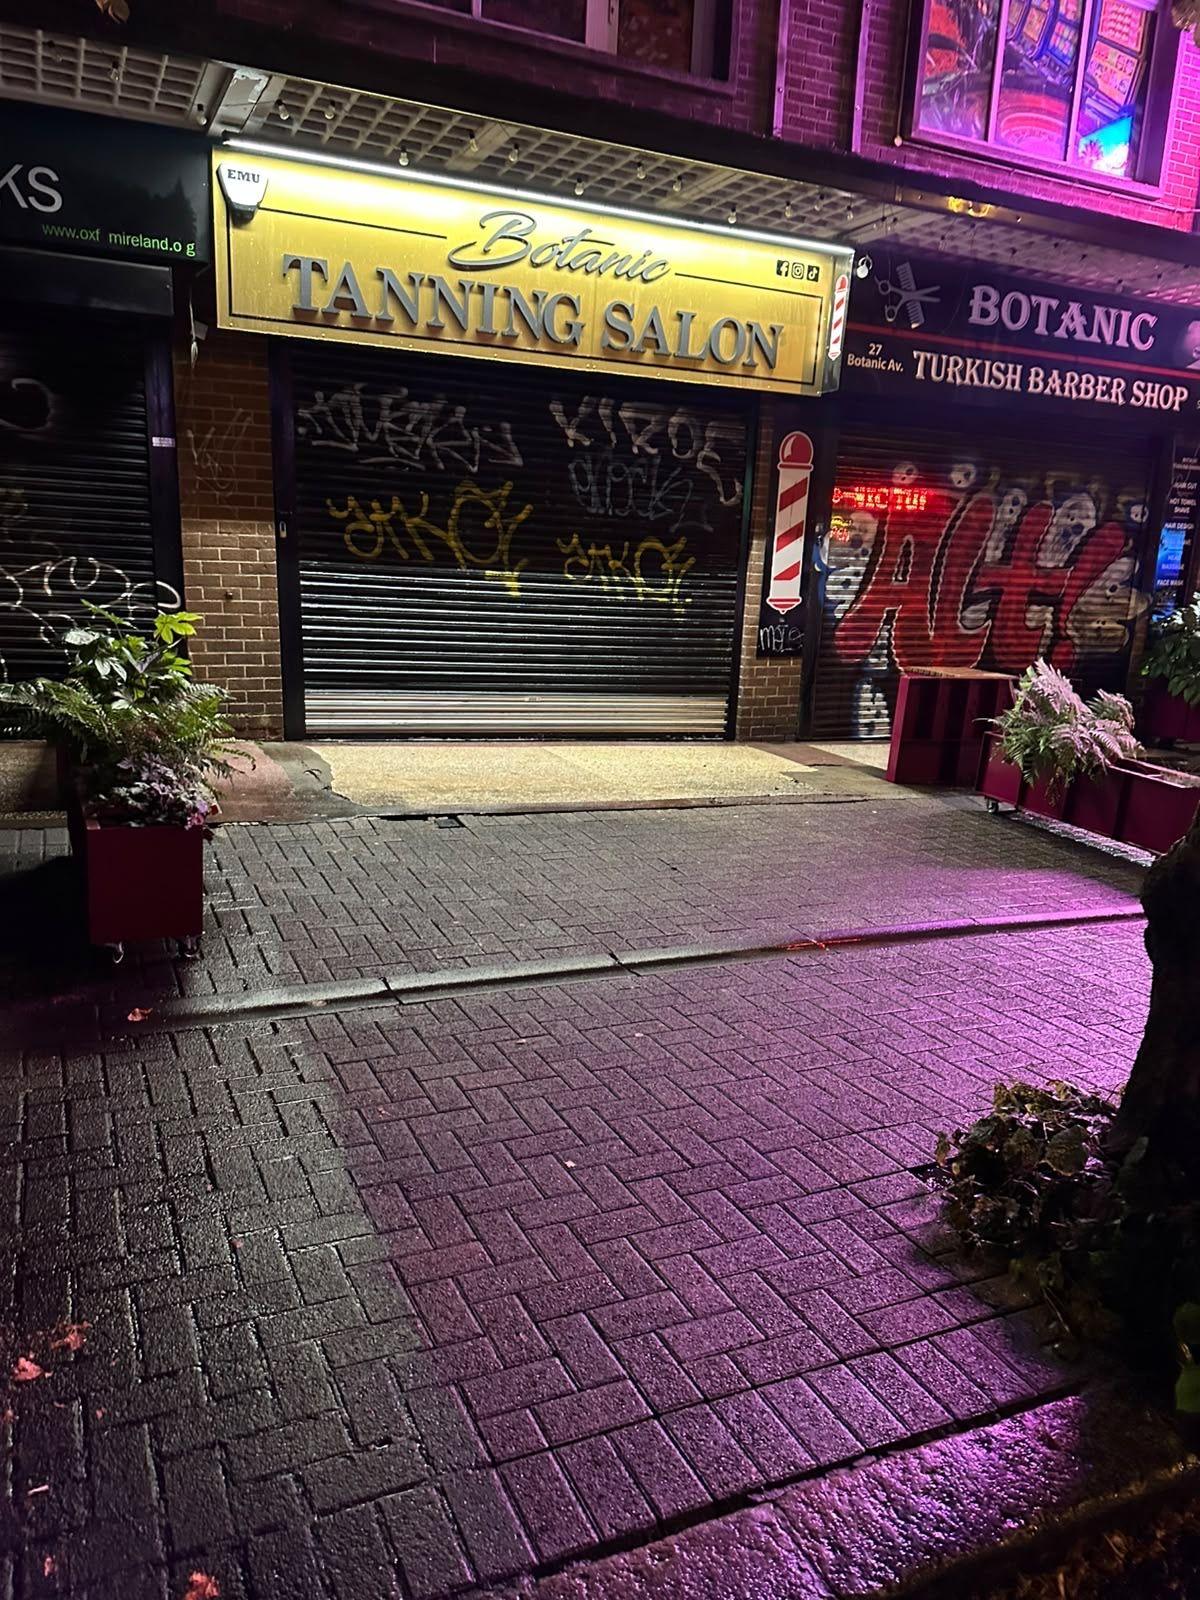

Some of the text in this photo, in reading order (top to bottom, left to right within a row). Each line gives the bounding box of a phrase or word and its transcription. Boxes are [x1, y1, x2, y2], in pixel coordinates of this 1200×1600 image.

[227, 168, 261, 184] EMU
[42, 224, 196, 257] www.oxfmireland.og
[448, 210, 677, 284] Botanic
[283, 254, 785, 370] TANNING SALON
[968, 285, 1158, 351] BOTANIC
[847, 353, 904, 372] Botanic Av.
[868, 343, 882, 356] 27
[913, 350, 1189, 411] TURKISH BARBER SHOP
